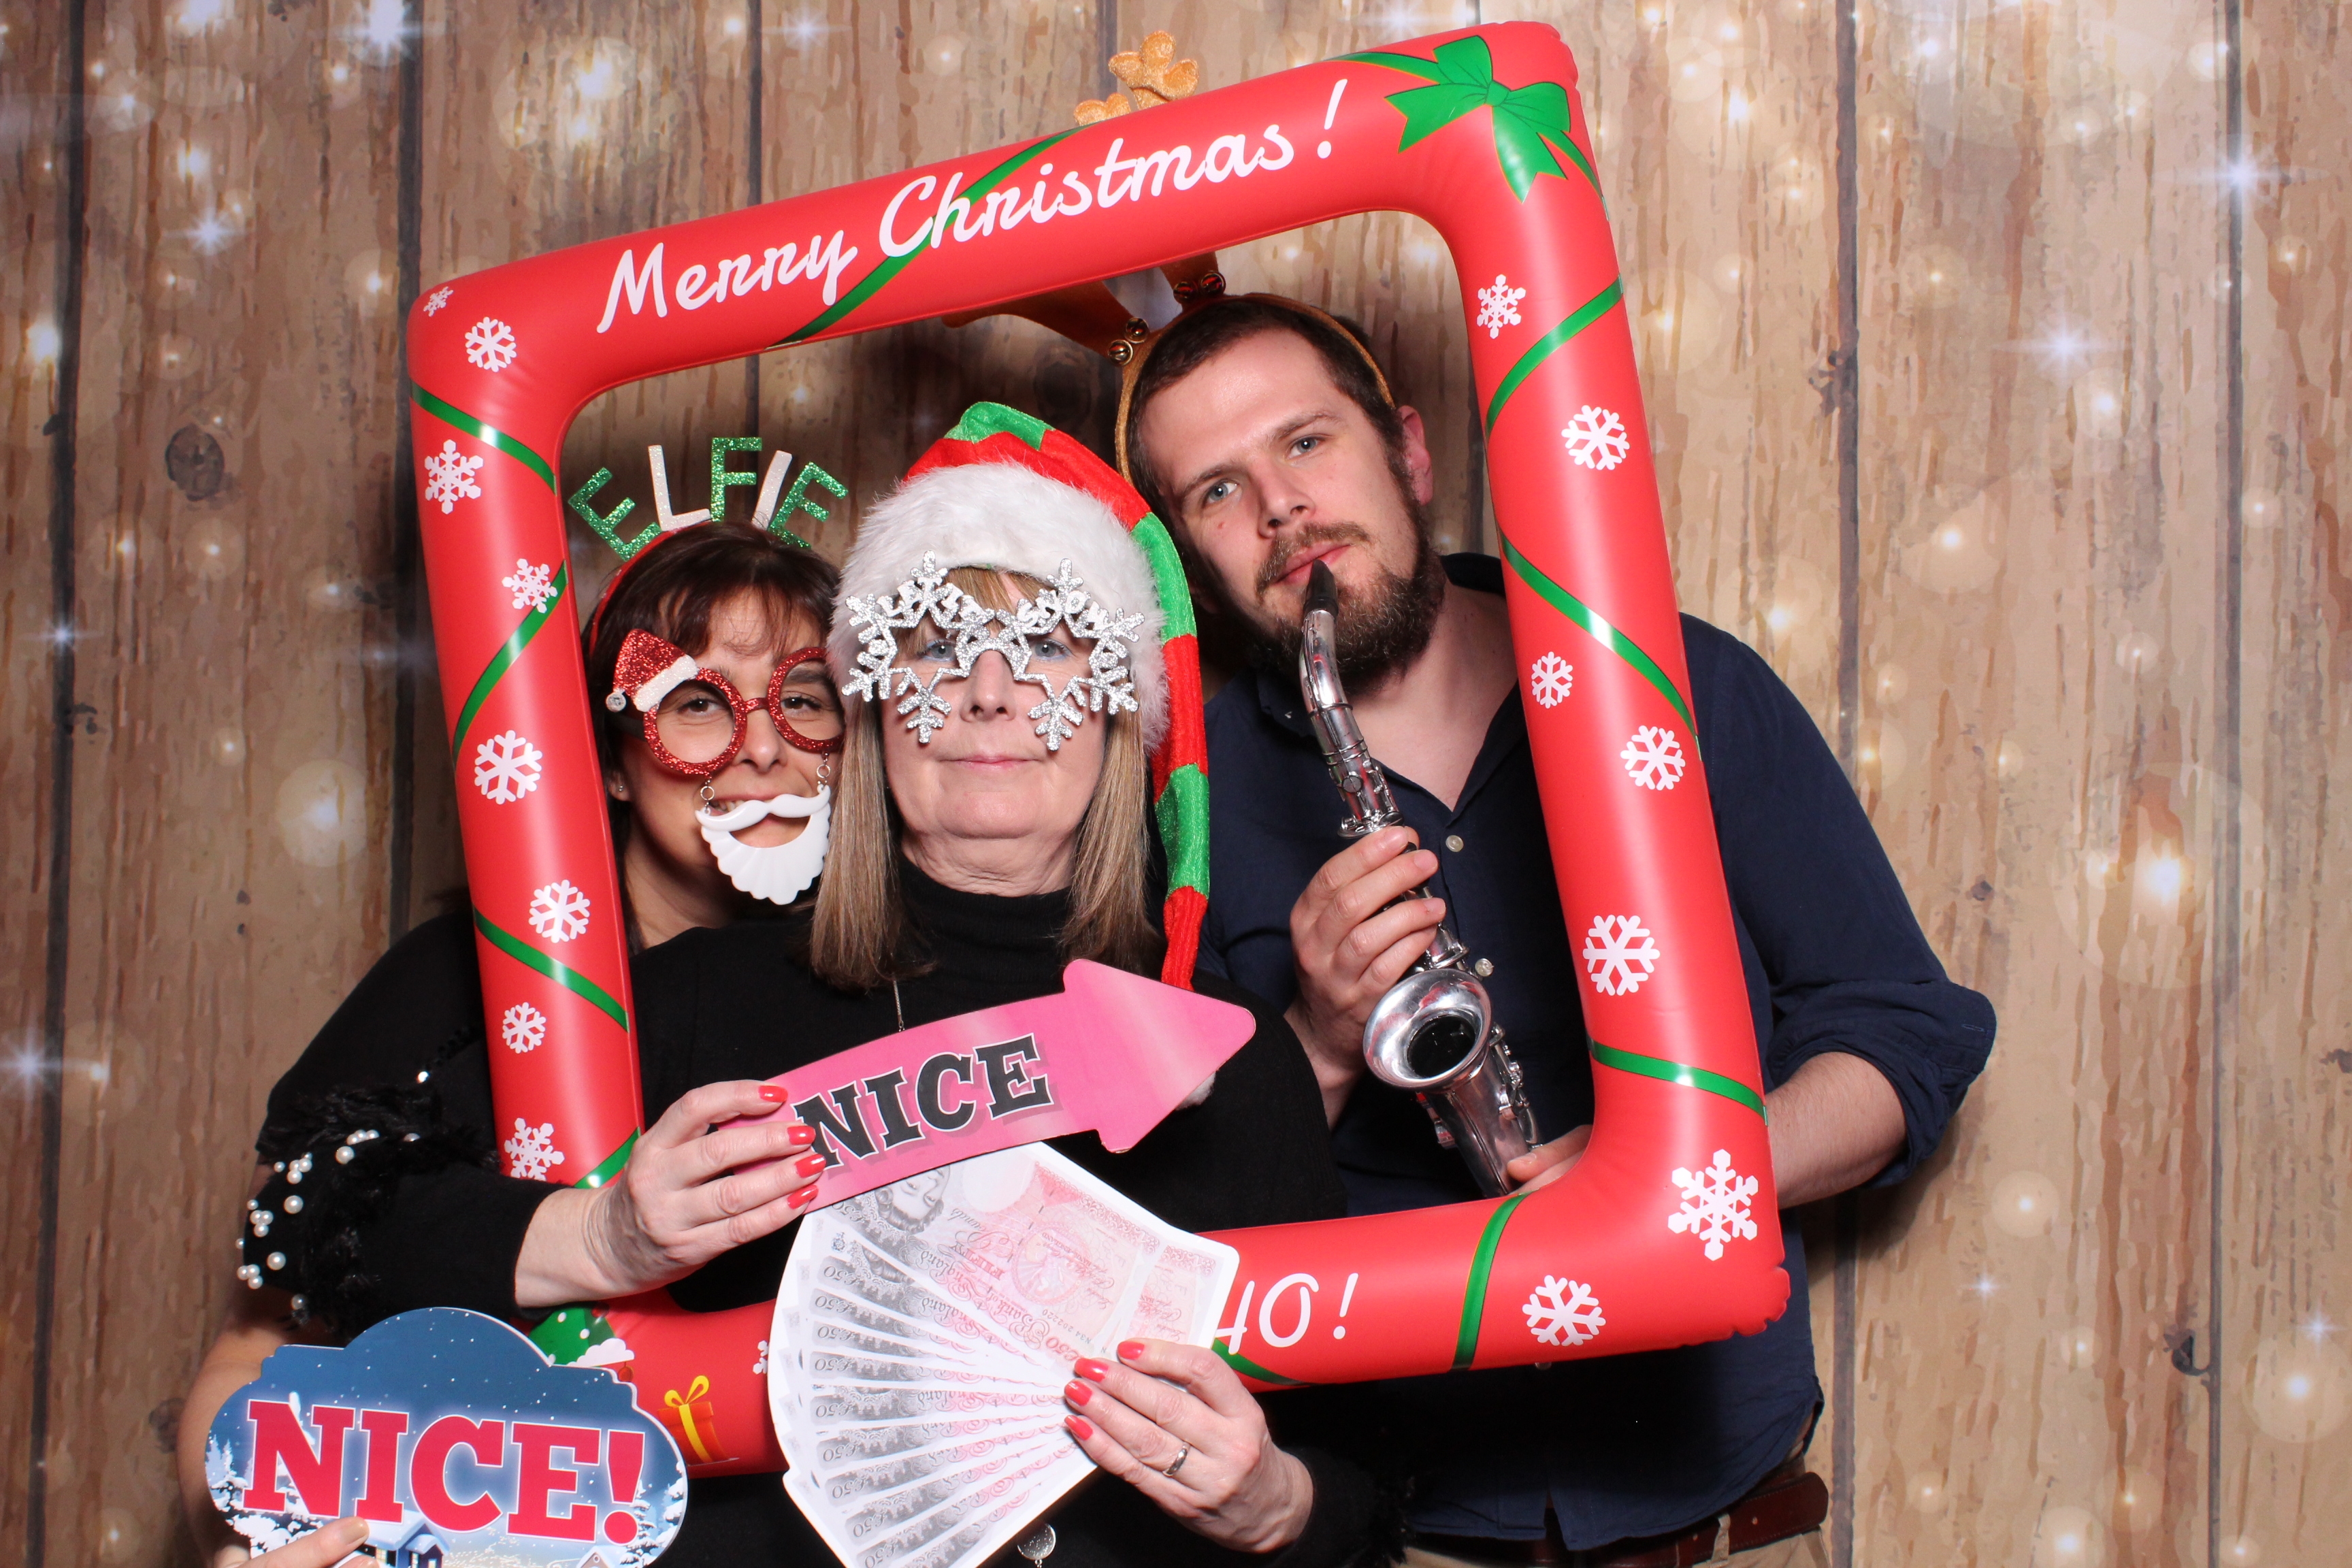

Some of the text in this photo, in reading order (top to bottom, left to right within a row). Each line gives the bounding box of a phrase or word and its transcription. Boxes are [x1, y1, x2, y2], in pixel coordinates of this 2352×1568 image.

[597, 234, 858, 333] Merry
[568, 436, 849, 561] ELFIE
[790, 1032, 1055, 1171] NICE
[949, 1241, 1005, 1281] FIFTY
[242, 1398, 647, 1546] NICE!
